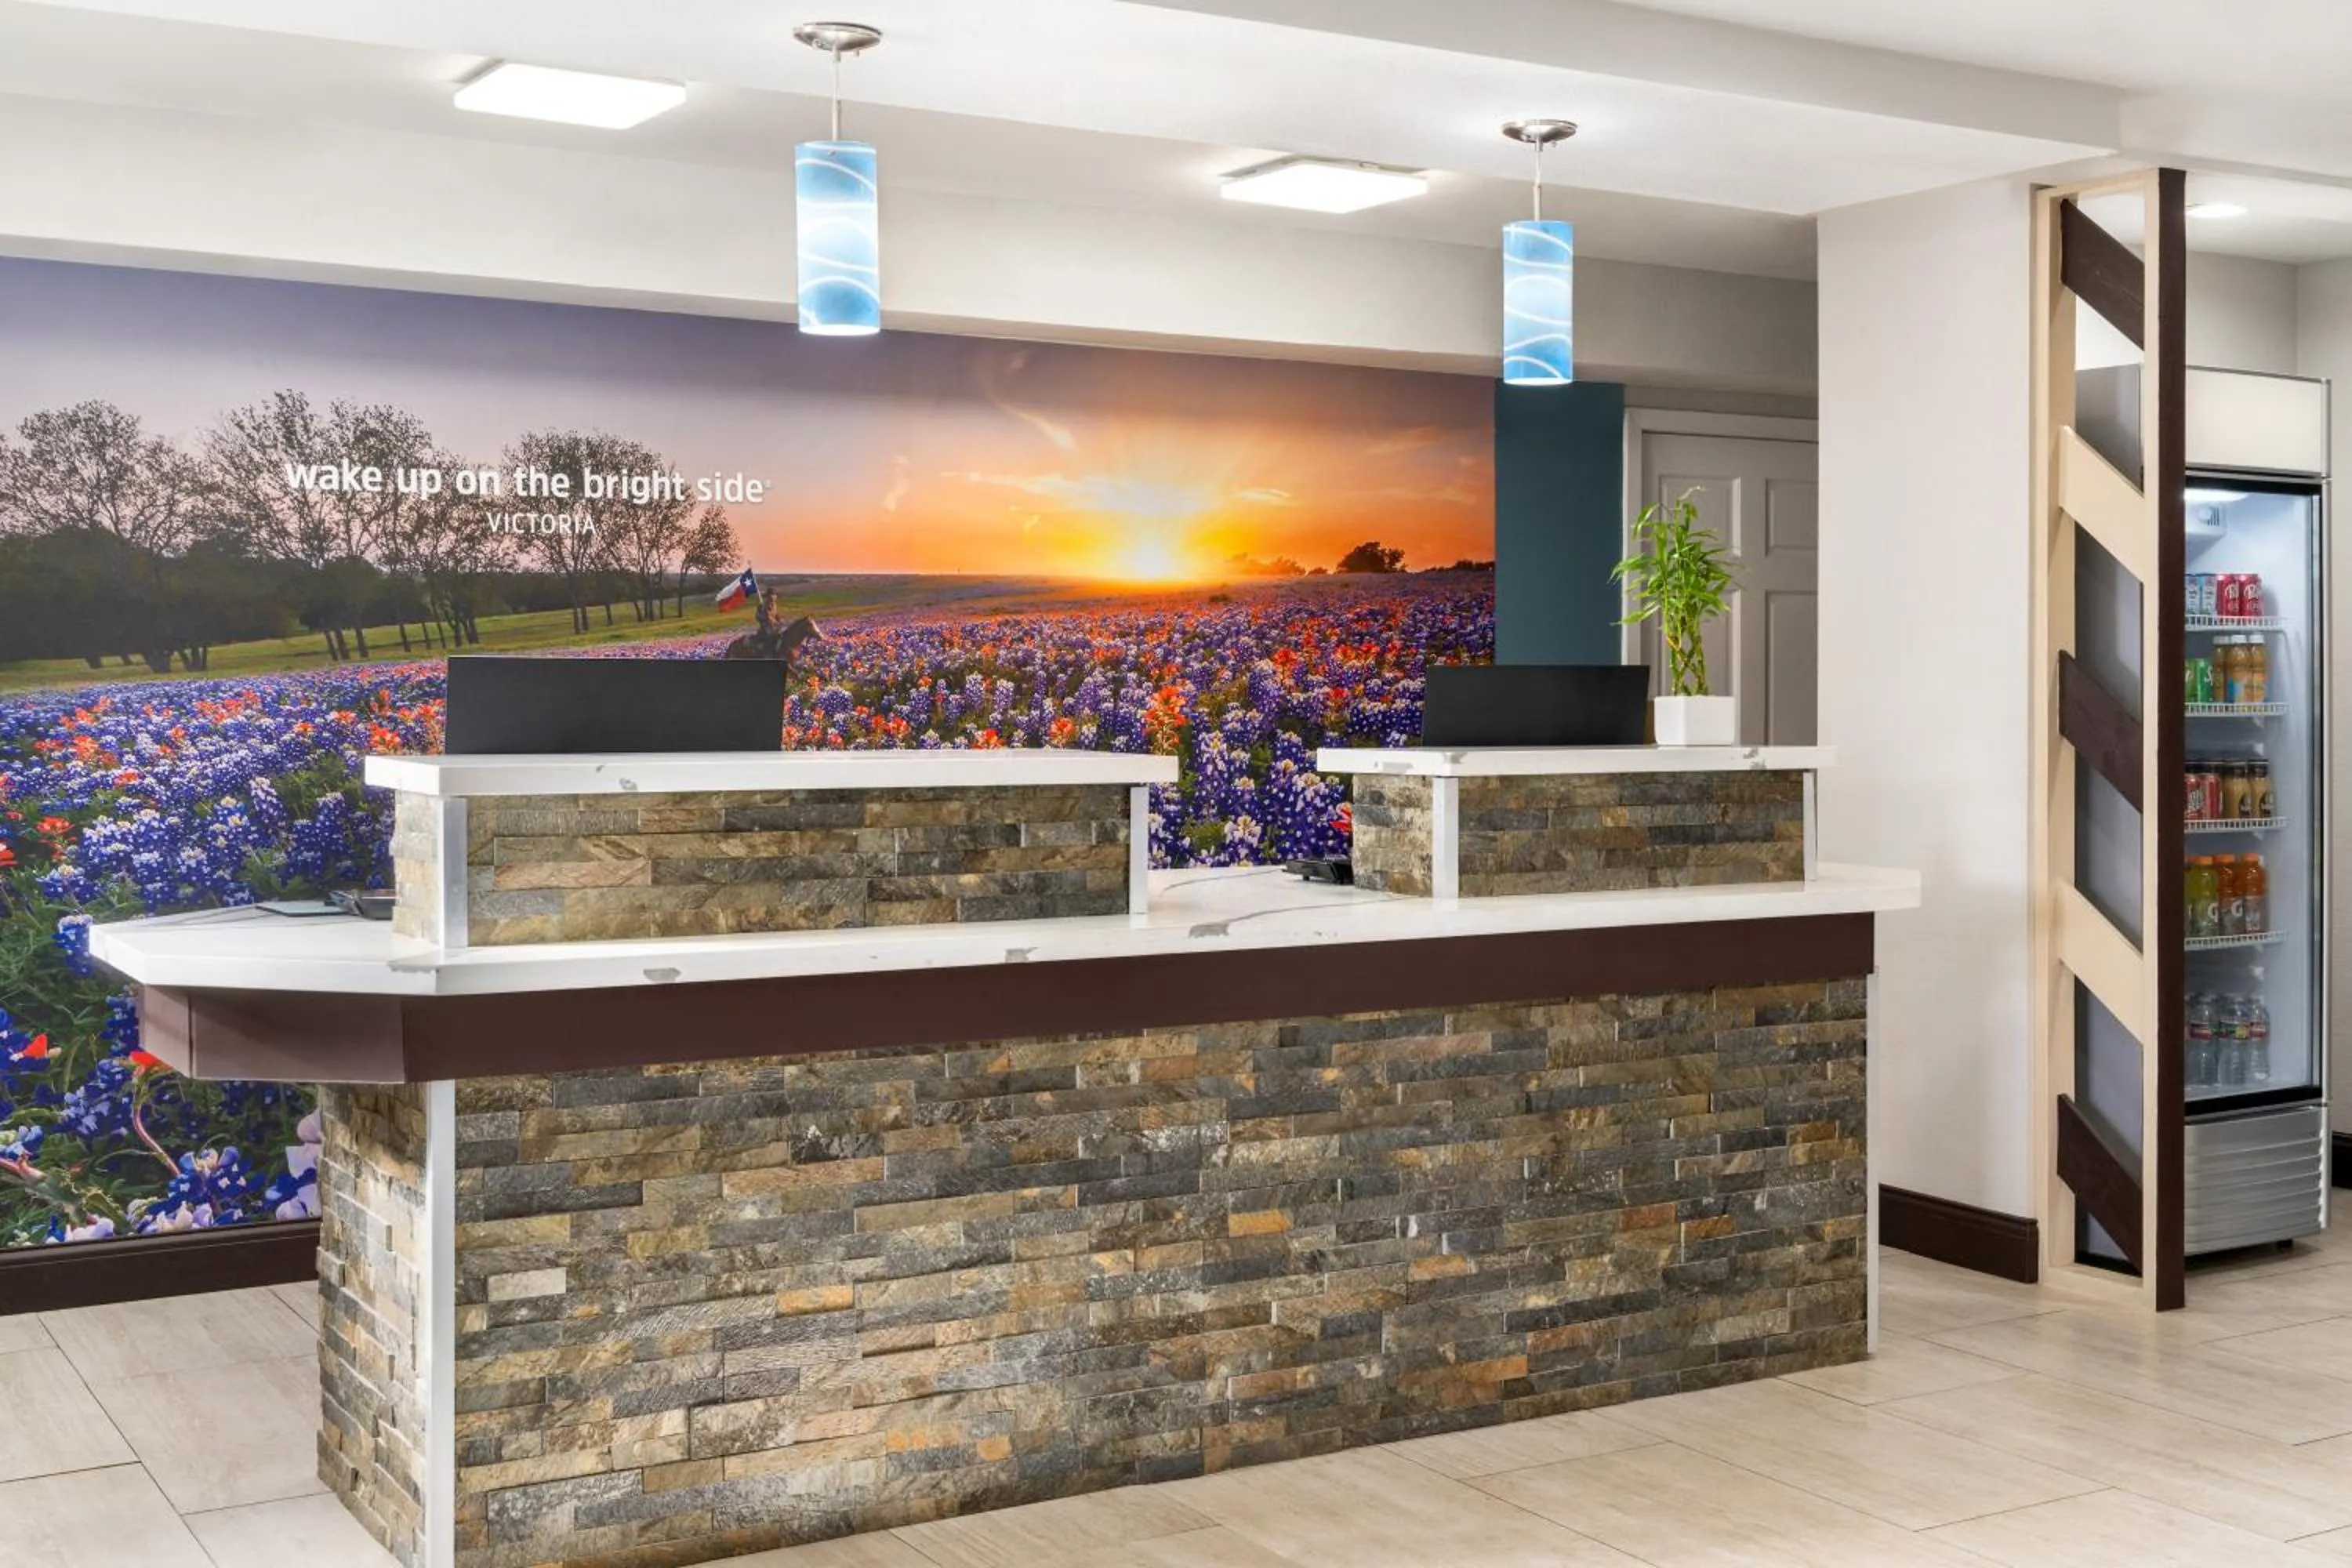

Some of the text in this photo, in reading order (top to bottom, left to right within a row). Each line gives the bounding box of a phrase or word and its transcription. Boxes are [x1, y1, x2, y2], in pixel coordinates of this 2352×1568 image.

[285, 458, 383, 492] wake
[397, 467, 442, 500] up
[456, 470, 500, 495] on
[514, 466, 570, 498] the
[583, 467, 686, 504] bright
[486, 512, 597, 535] VICTORIA
